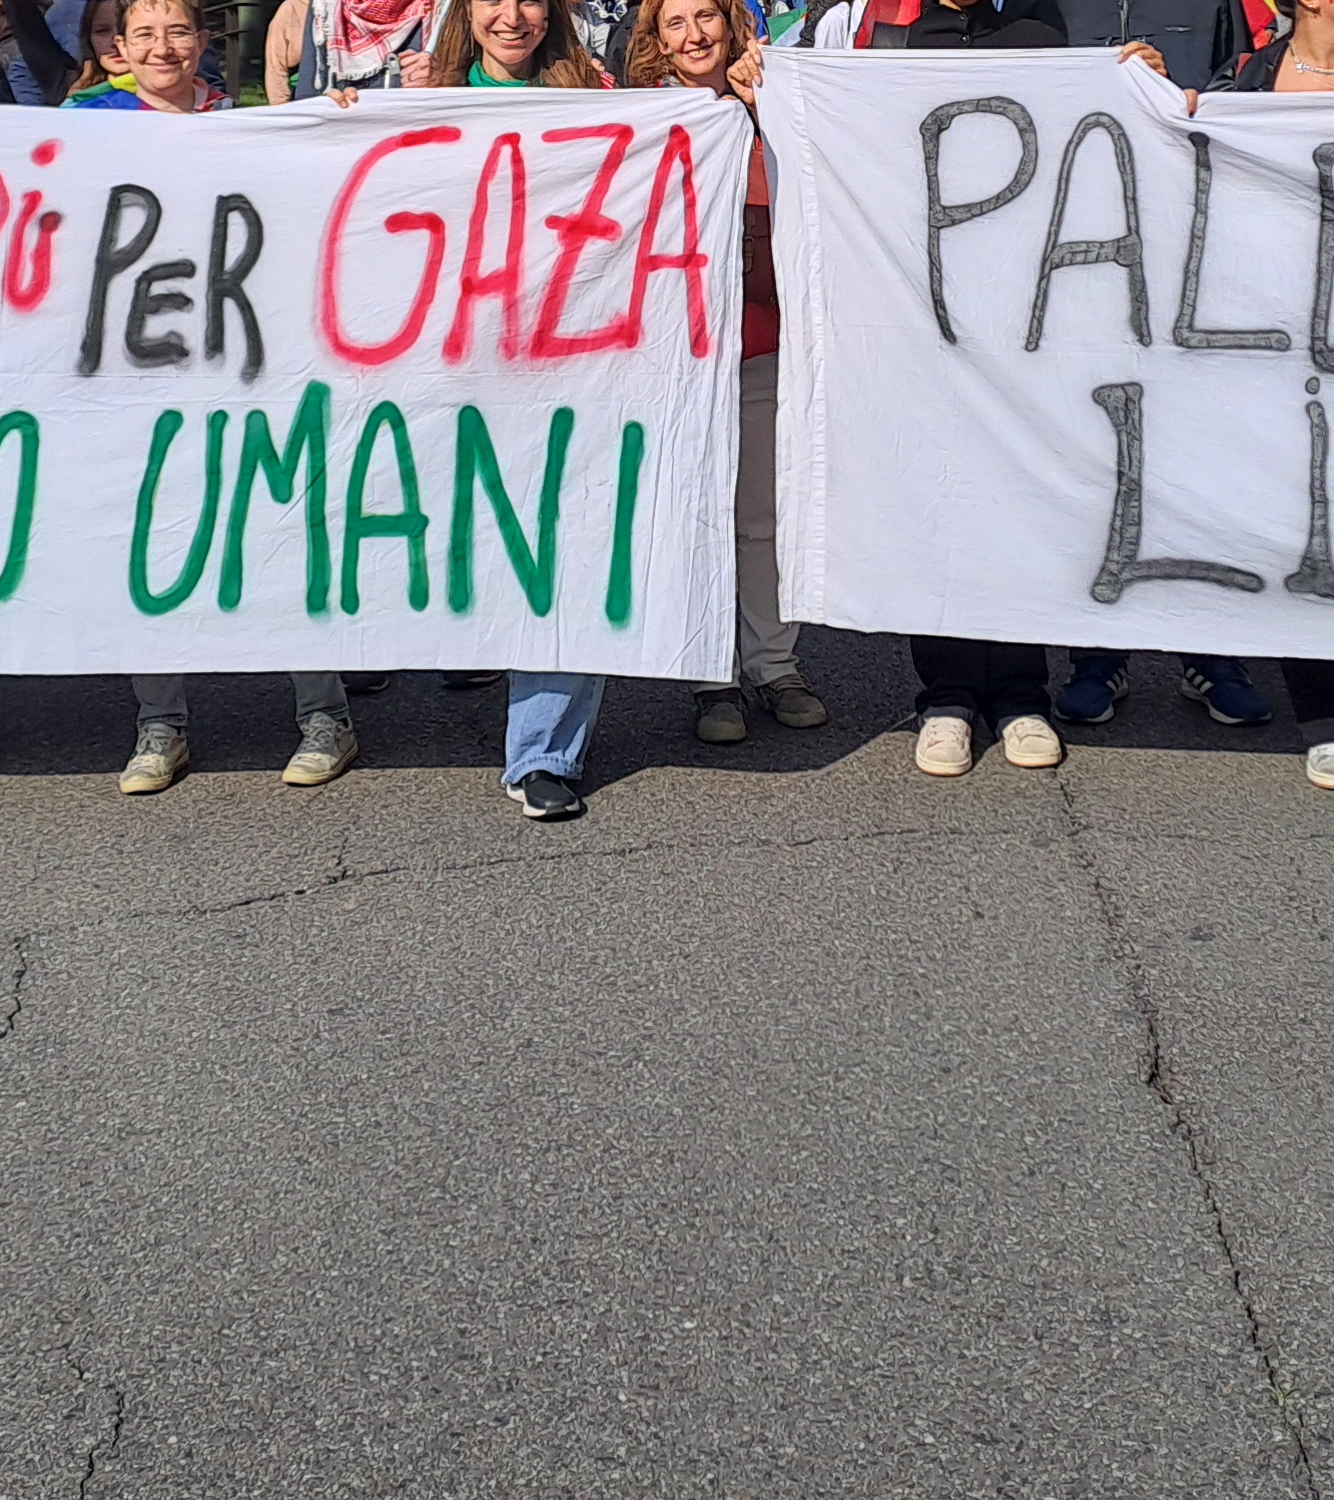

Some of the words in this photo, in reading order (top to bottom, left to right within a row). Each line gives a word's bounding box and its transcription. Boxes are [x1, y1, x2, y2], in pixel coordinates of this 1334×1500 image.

[78, 183, 265, 381] PER
[319, 122, 713, 369] GAZA
[128, 380, 646, 630] UMANI
